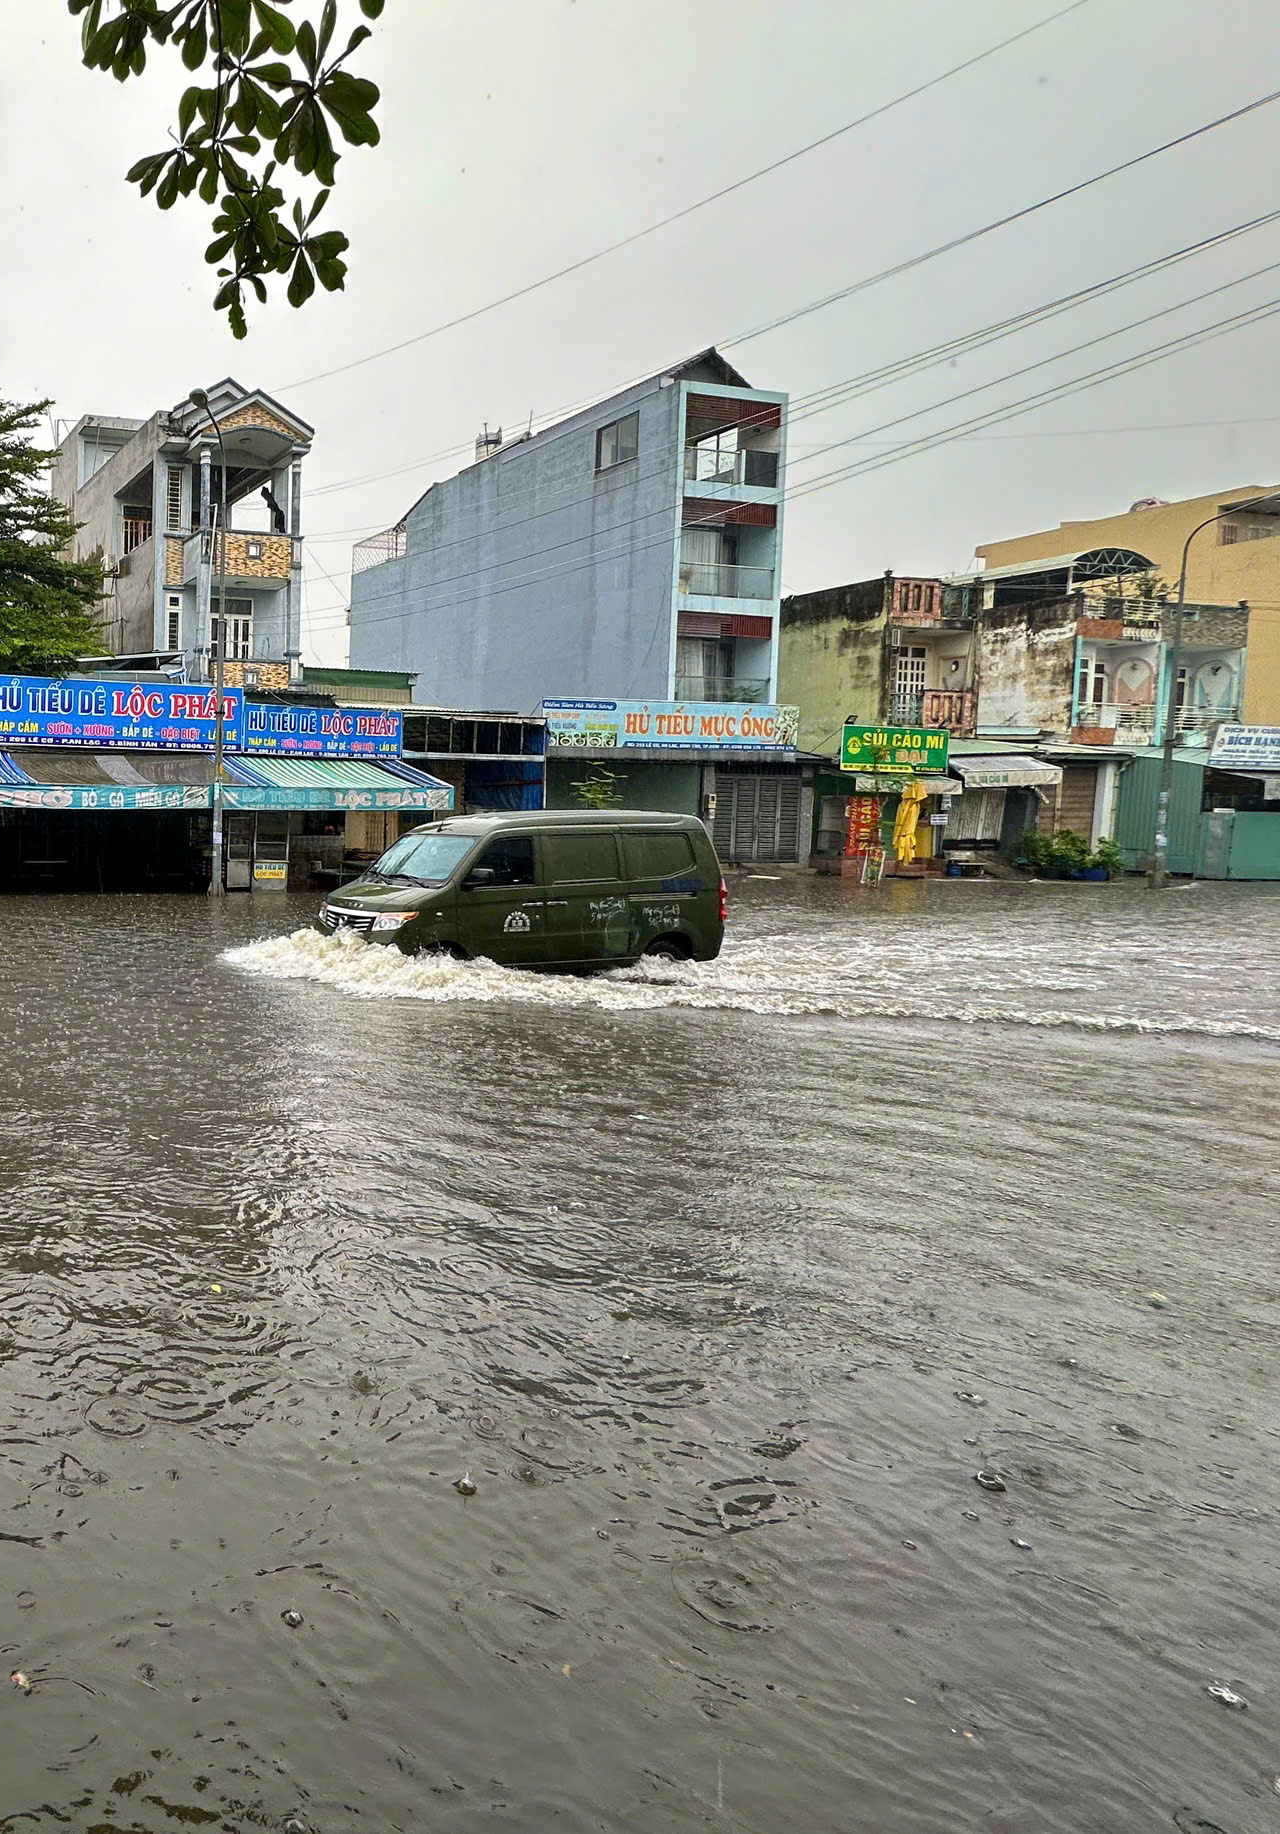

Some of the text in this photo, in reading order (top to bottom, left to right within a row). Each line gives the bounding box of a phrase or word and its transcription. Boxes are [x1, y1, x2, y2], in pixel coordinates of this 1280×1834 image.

[27, 681, 74, 714] TIẾU
[78, 686, 106, 716] DÊ
[111, 685, 164, 723] LỘC
[169, 688, 238, 720] PHÁT
[18, 718, 38, 733] CẨM
[83, 723, 114, 736] XƯƠNG
[181, 727, 200, 741] BIỆT
[248, 705, 399, 739] HỦ TIẾU DÊ LỘC PHÁT
[625, 705, 775, 742] HỦ TIẾU MỰC ỐNG
[863, 729, 887, 746] SỦI
[892, 730, 921, 748] CẢO
[334, 789, 371, 809] LỘC
[375, 789, 427, 807] PHÁT
